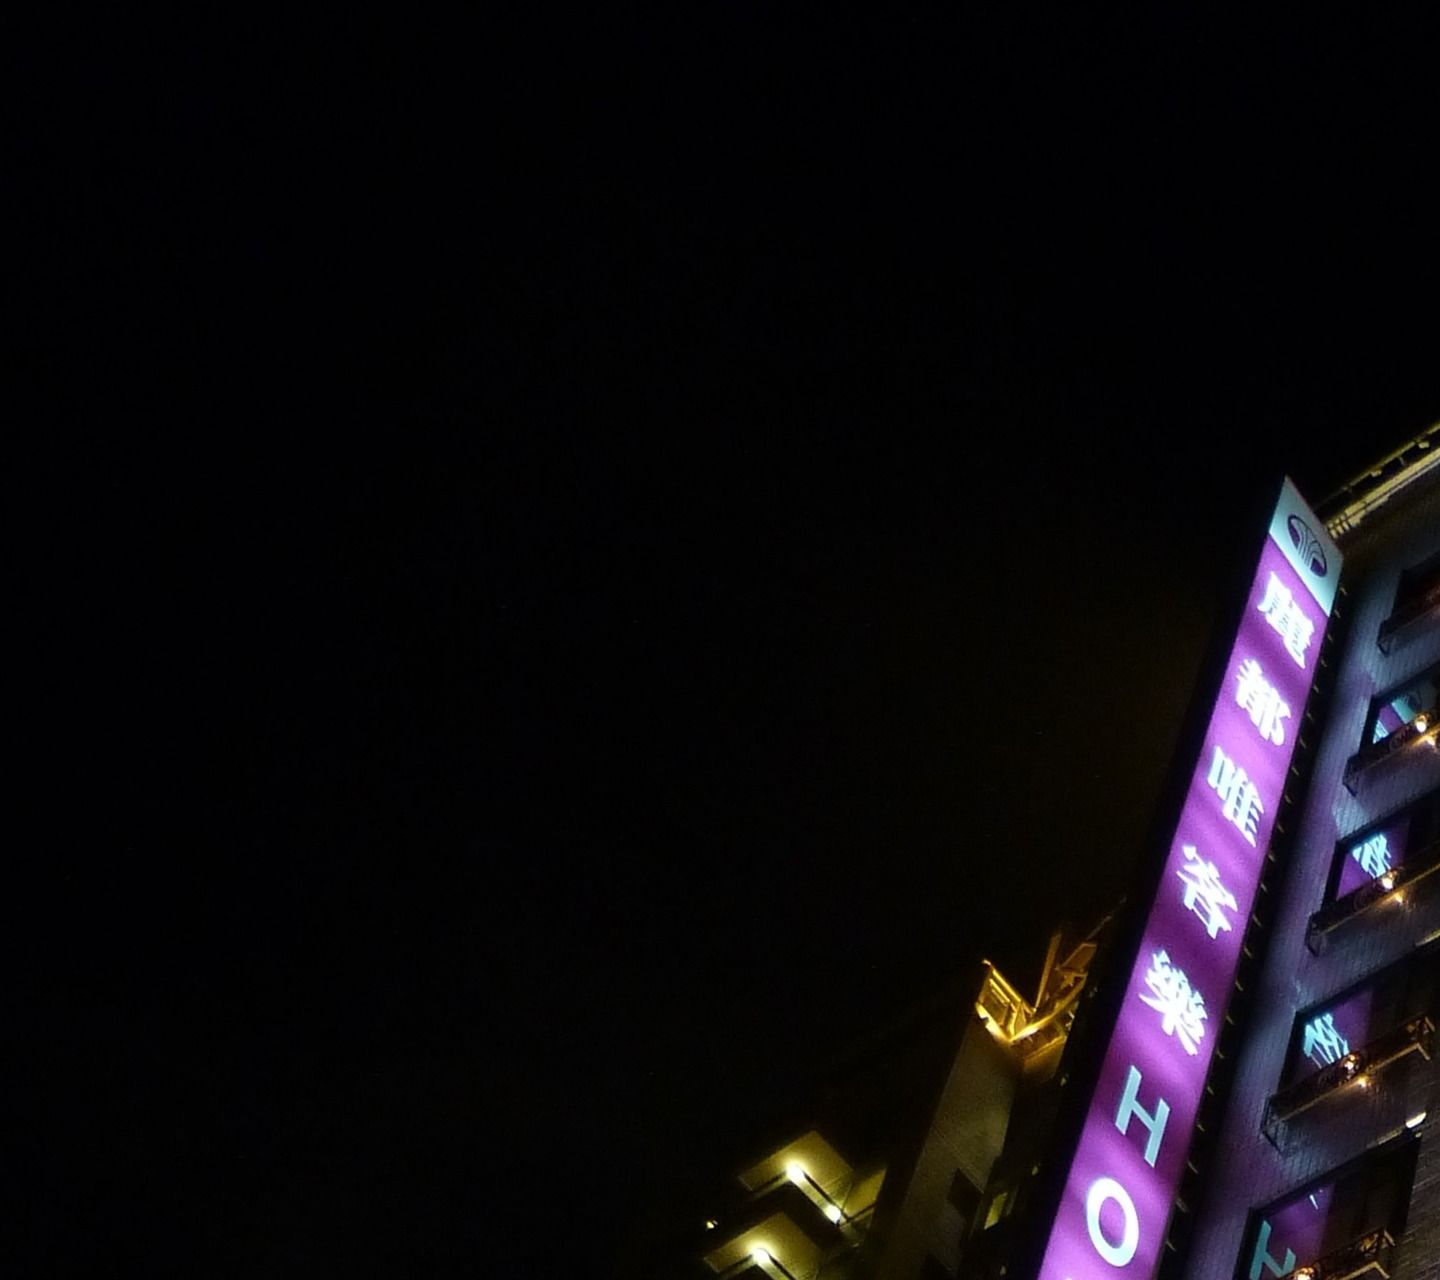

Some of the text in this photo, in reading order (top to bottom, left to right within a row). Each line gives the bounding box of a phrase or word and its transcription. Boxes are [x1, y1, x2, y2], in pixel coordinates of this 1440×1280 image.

[1141, 571, 1317, 1057] 麗都唯客樂
